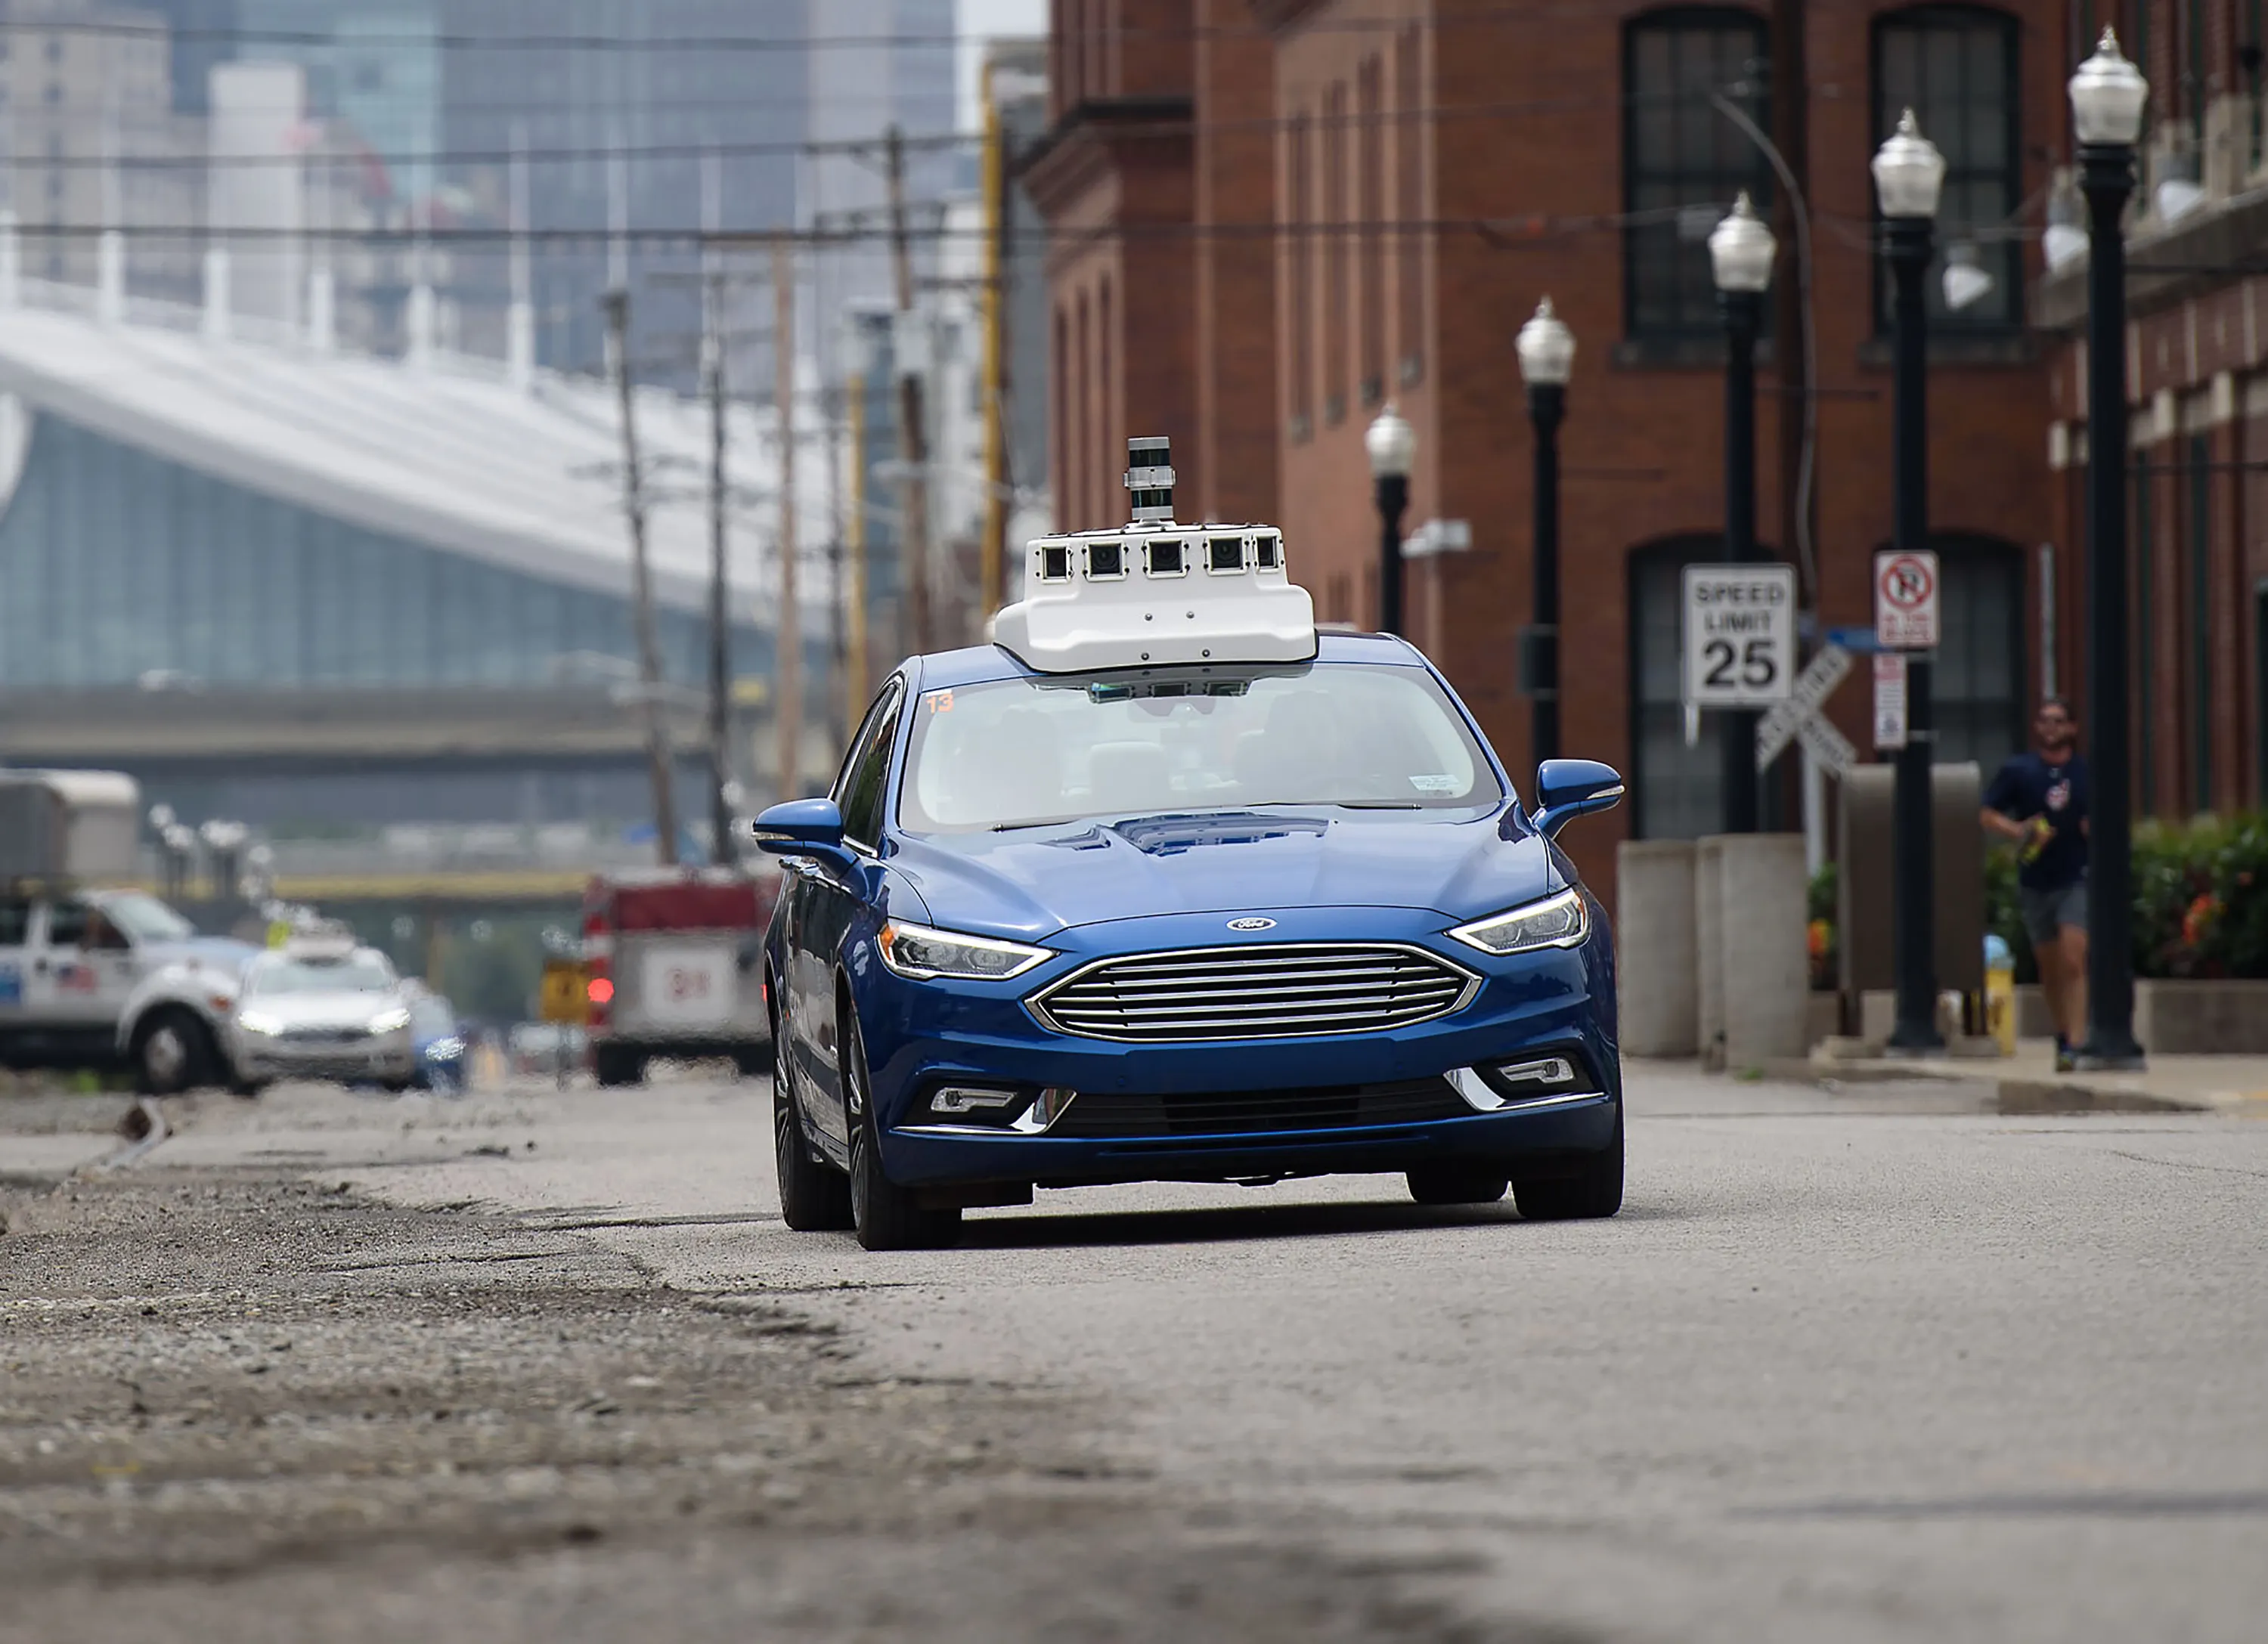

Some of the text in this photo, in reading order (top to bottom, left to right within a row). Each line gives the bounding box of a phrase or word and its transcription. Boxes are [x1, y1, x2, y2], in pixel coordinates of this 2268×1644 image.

[1696, 581, 1785, 605] SPEED
[1703, 610, 1772, 633] LIMIT
[1703, 639, 1778, 689] 25
[925, 694, 955, 714] 13
[1233, 918, 1267, 929] Ford
